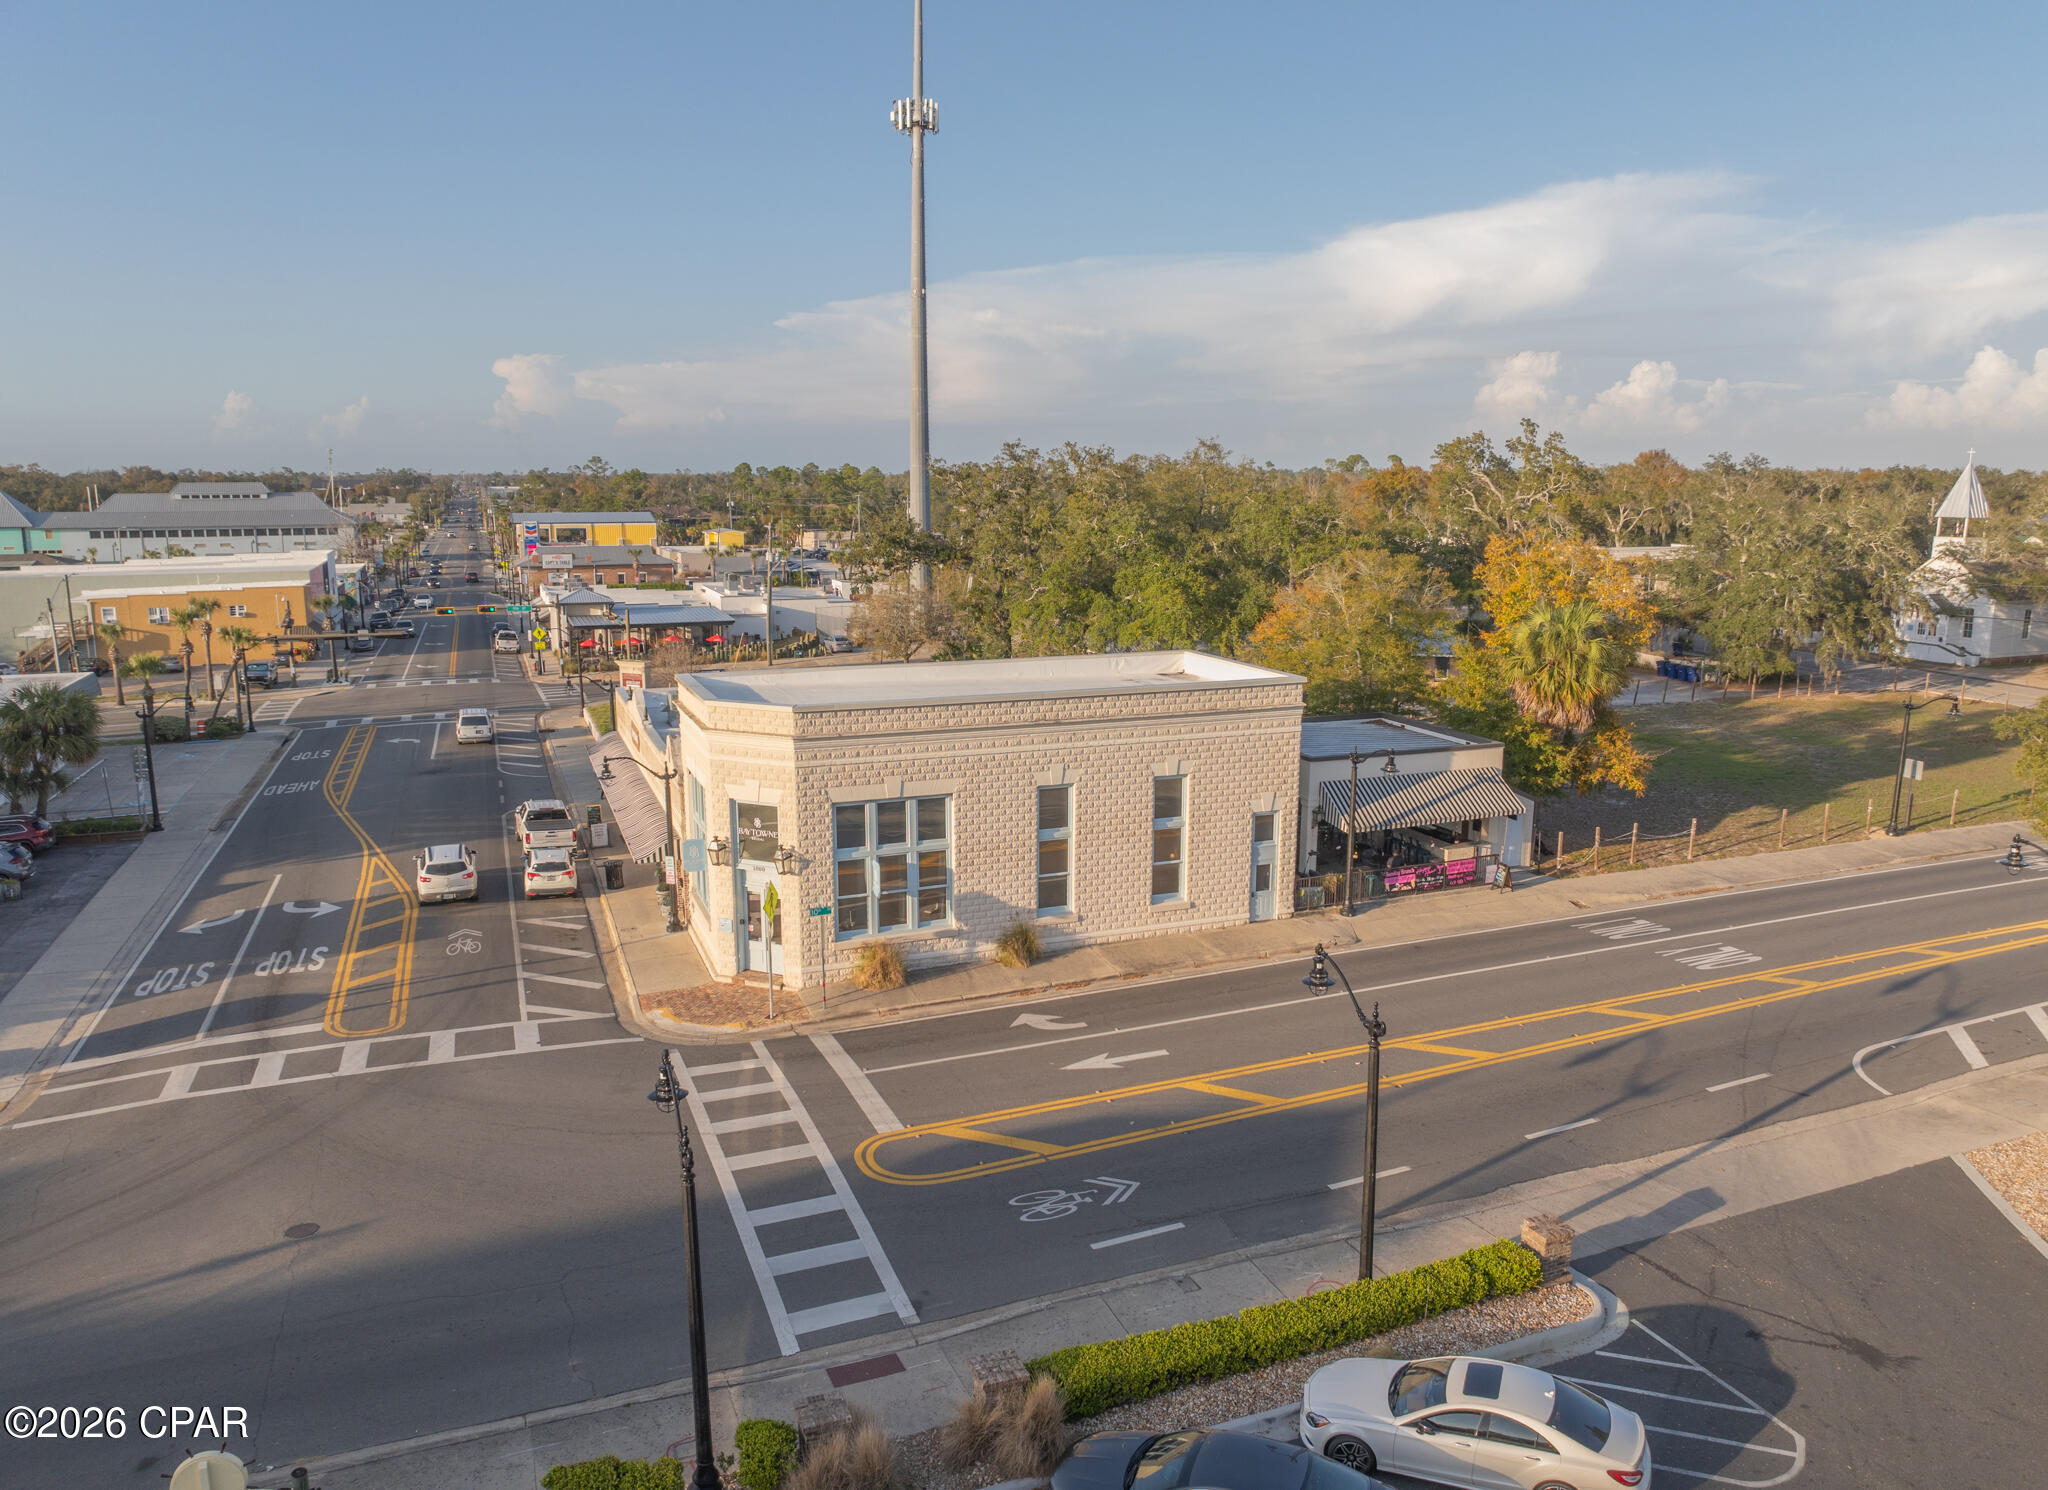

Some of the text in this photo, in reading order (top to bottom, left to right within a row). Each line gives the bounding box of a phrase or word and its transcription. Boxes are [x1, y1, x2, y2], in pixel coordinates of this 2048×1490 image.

[291, 749, 332, 760] STOP
[264, 780, 320, 795] AHEAD
[738, 827, 778, 838] BAYTOWNE
[1570, 917, 1671, 939] ONLY
[254, 946, 329, 976] STOP
[1654, 942, 1762, 970] ONLY
[134, 962, 215, 996] STOP
